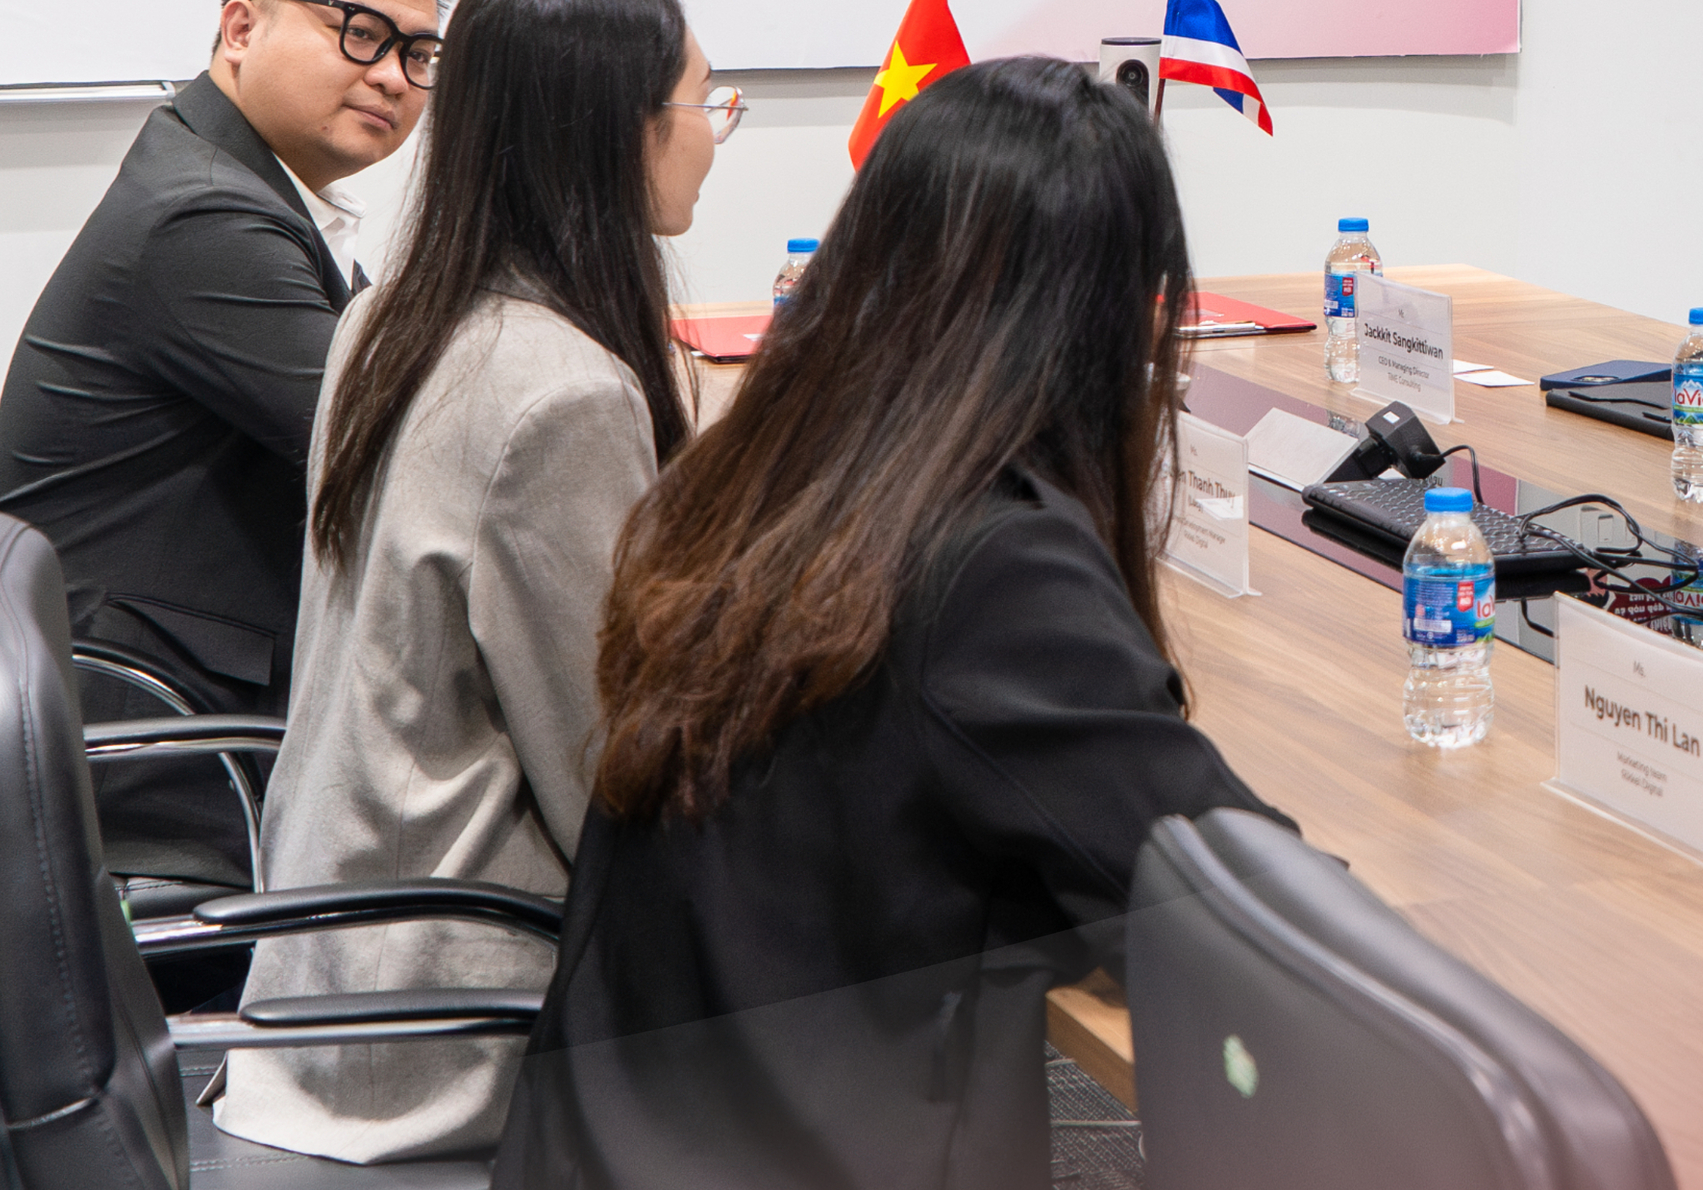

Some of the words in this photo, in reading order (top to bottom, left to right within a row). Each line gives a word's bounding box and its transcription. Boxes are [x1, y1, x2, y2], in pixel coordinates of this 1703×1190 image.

[1364, 322, 1392, 344] Jackkit
[1585, 684, 1641, 731] Nguyen
[1645, 711, 1668, 743] Thi
[1673, 723, 1700, 758] Lan
